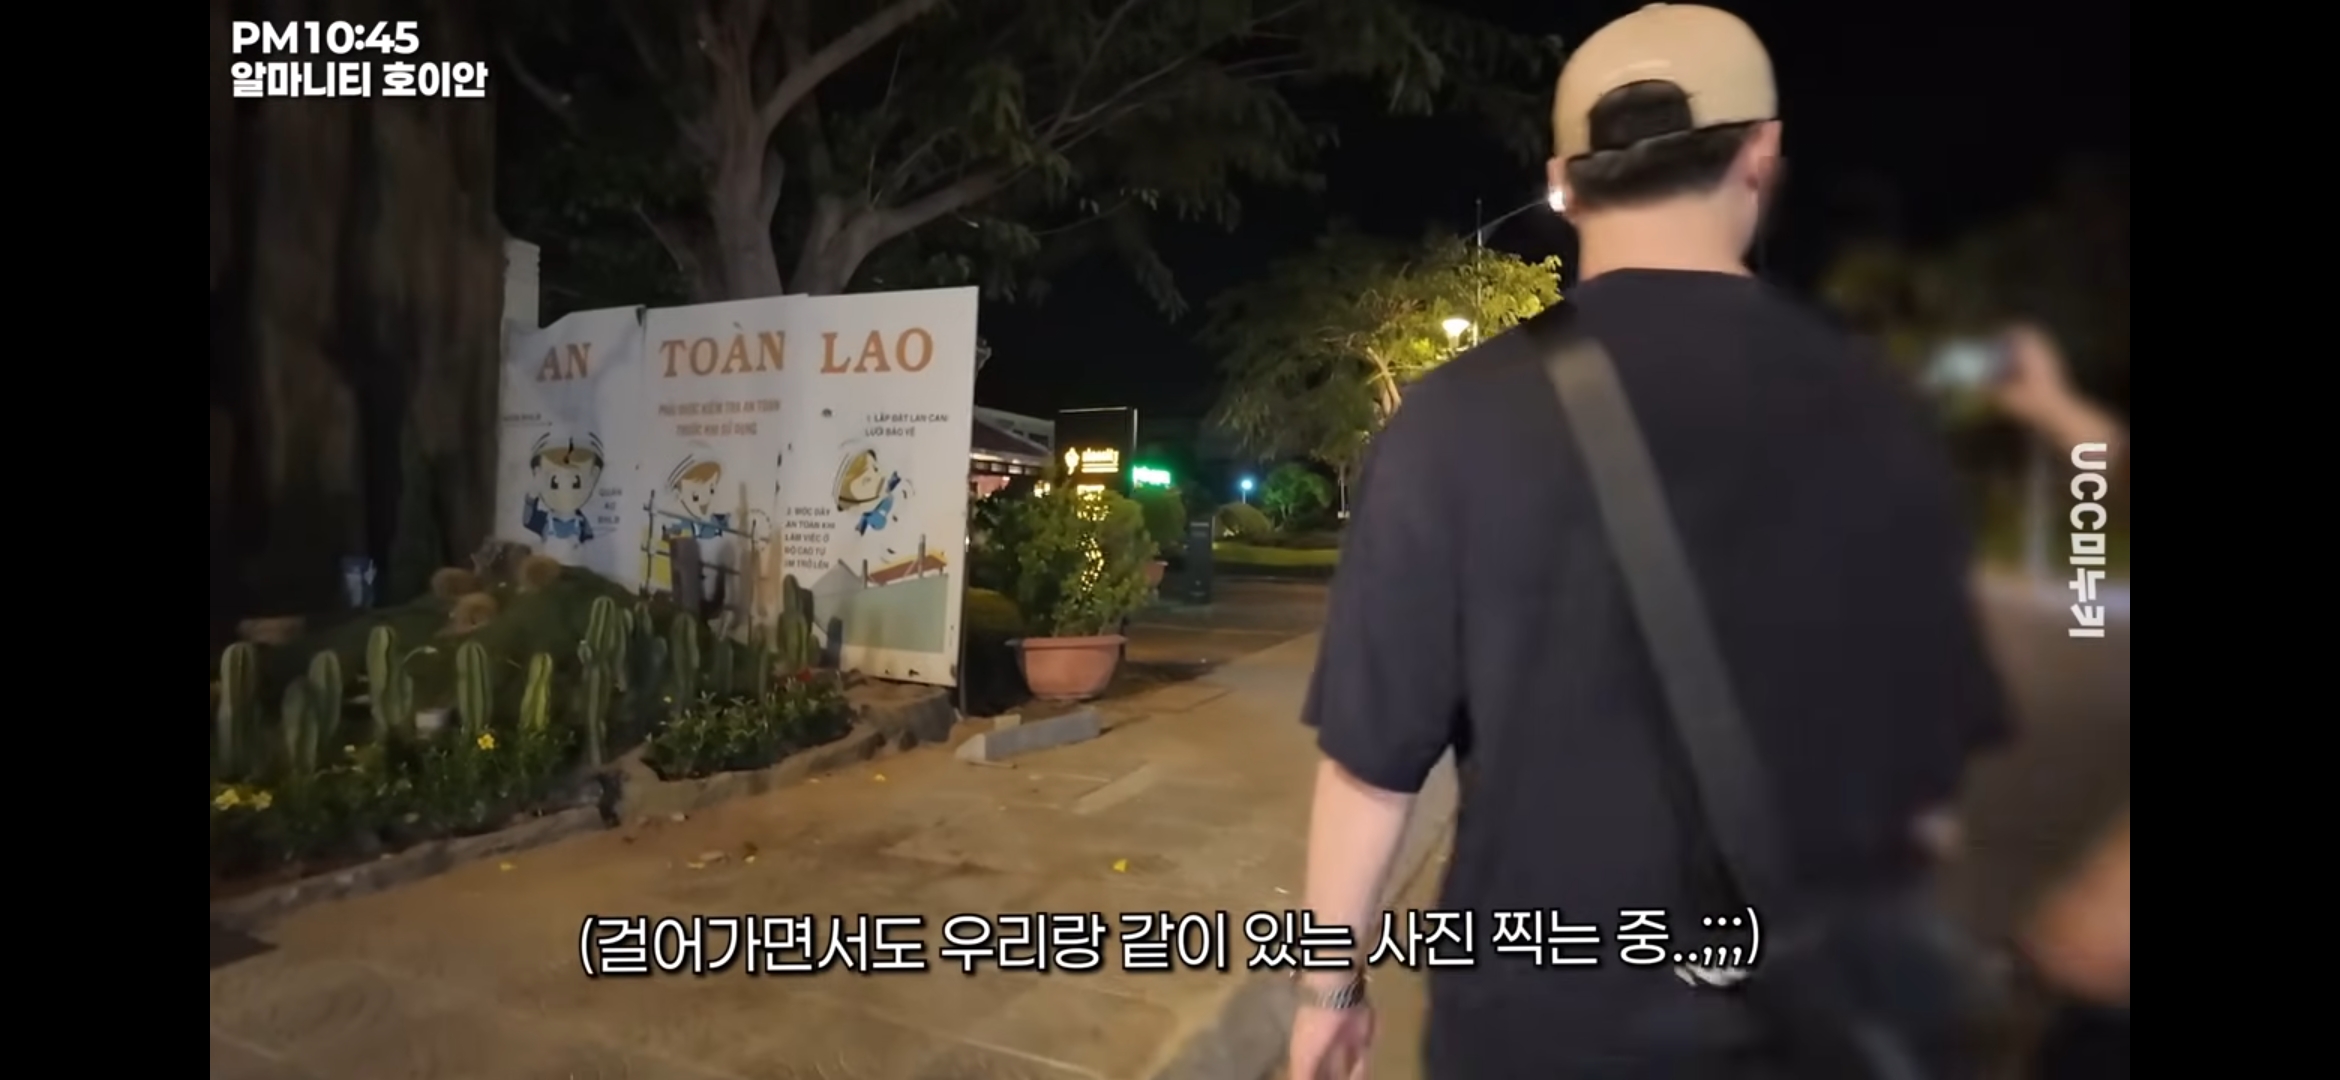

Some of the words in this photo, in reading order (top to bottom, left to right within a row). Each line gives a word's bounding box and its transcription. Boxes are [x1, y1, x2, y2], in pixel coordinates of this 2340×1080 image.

[536, 342, 592, 383] AN
[659, 322, 786, 378] TOÀN
[820, 327, 934, 375] LAO
